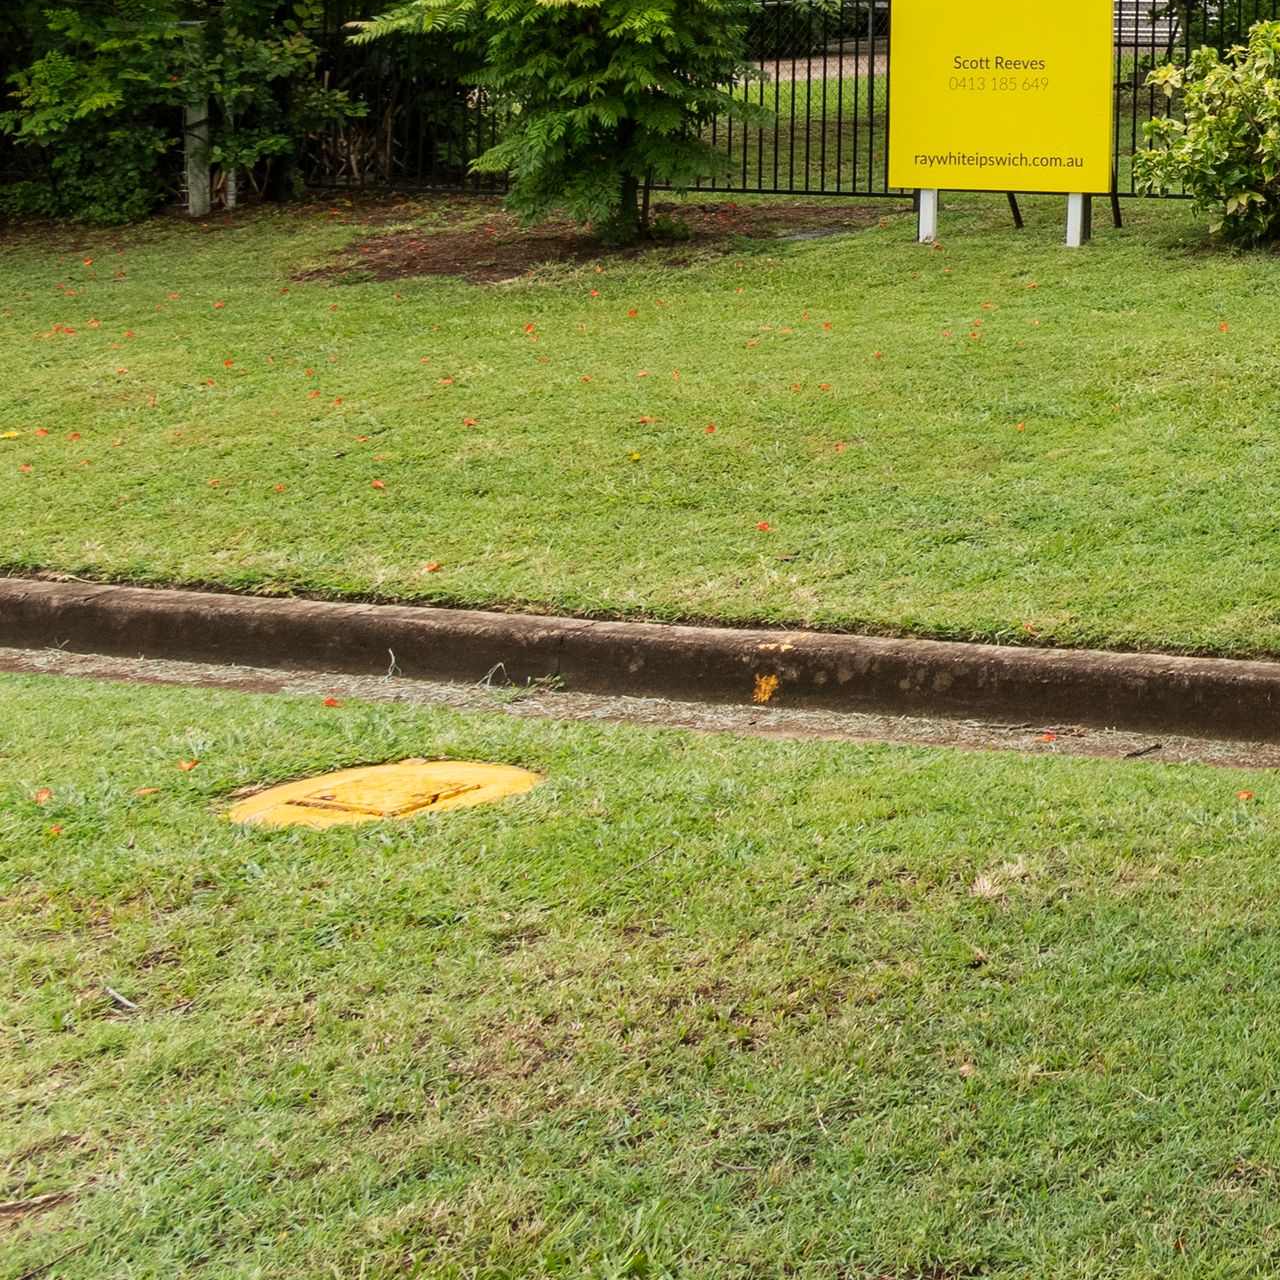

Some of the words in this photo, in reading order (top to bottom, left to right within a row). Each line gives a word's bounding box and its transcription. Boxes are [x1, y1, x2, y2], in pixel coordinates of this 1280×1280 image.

[953, 55, 991, 70] Scott
[994, 55, 1046, 70] Reeves
[948, 76, 986, 91] 0413
[990, 76, 1018, 91] 185
[1021, 77, 1050, 91] 649
[913, 152, 1084, 169] raywhiteipswich.com.au
